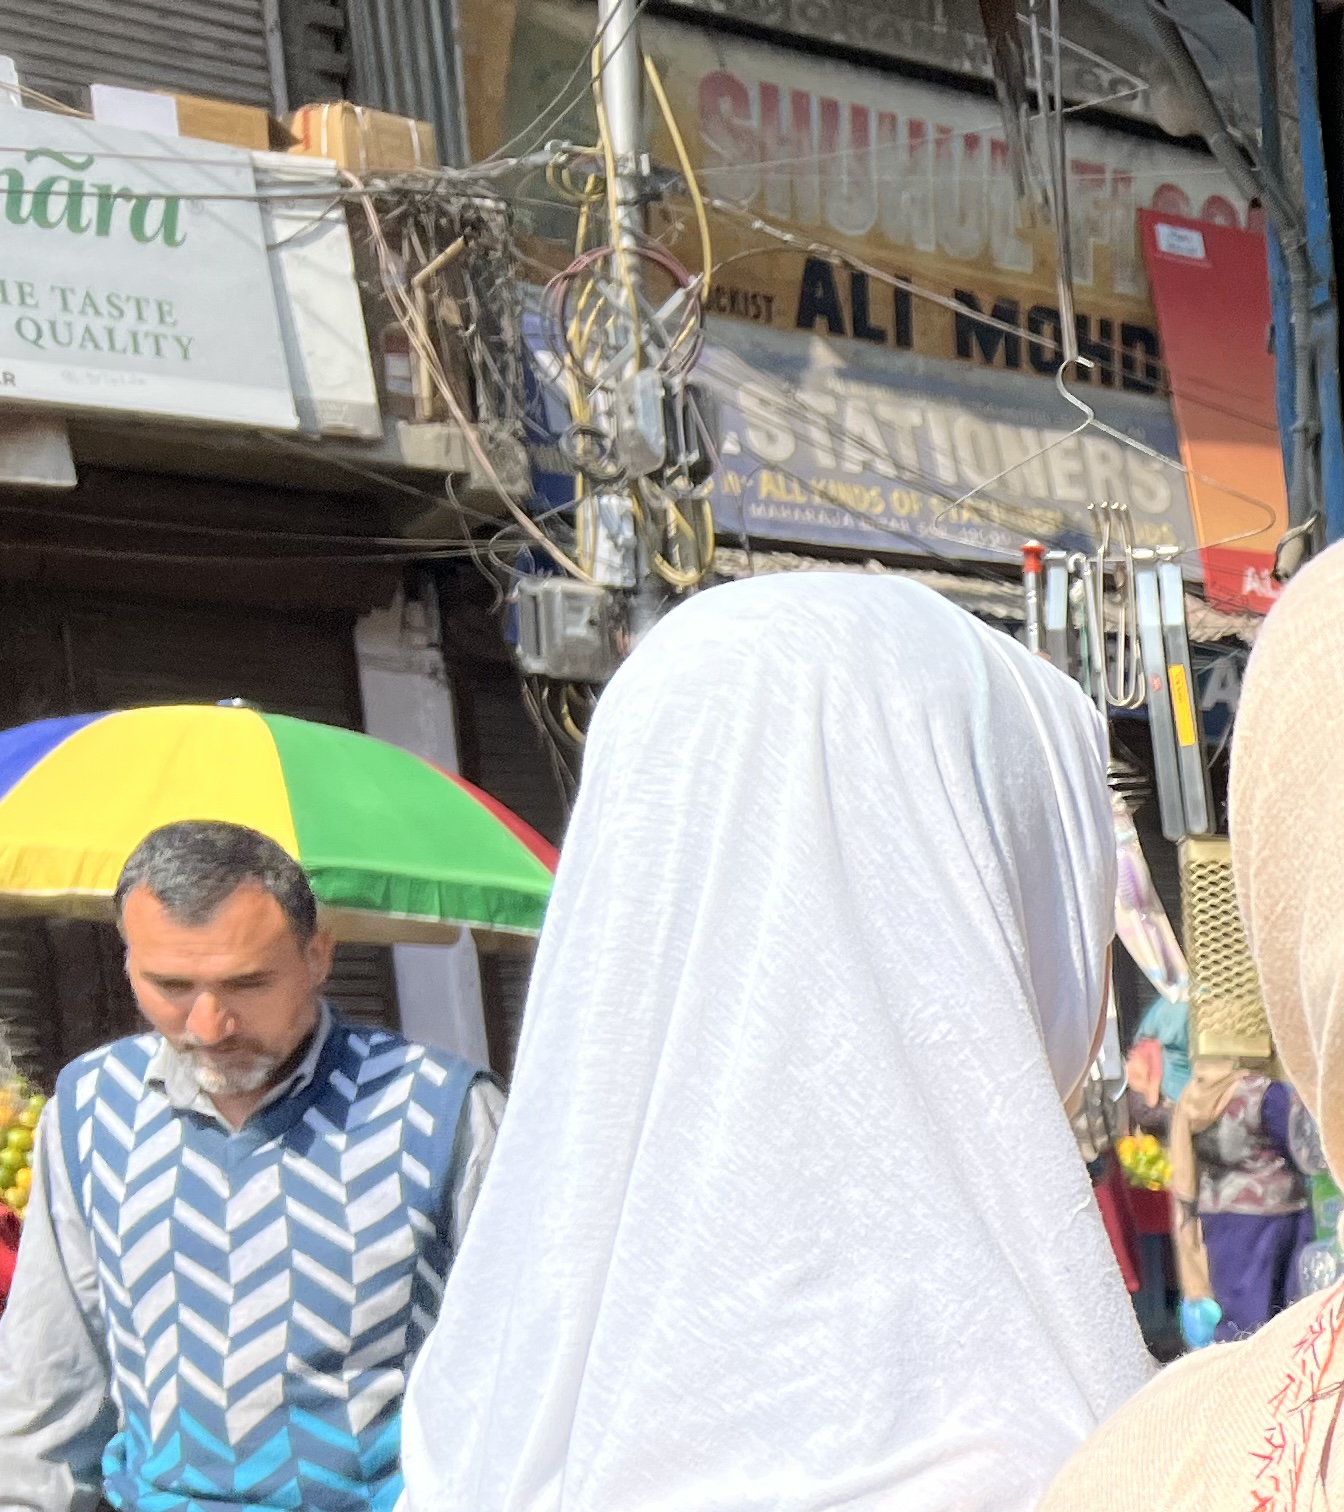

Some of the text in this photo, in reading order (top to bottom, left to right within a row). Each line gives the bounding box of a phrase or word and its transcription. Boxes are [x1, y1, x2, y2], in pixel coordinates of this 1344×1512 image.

[15, 316, 194, 362] QUALITY
[51, 286, 178, 328] TASTE
[796, 257, 914, 350] ALI
[953, 288, 1164, 396] MOHD
[738, 381, 1176, 515] STATIONERS
